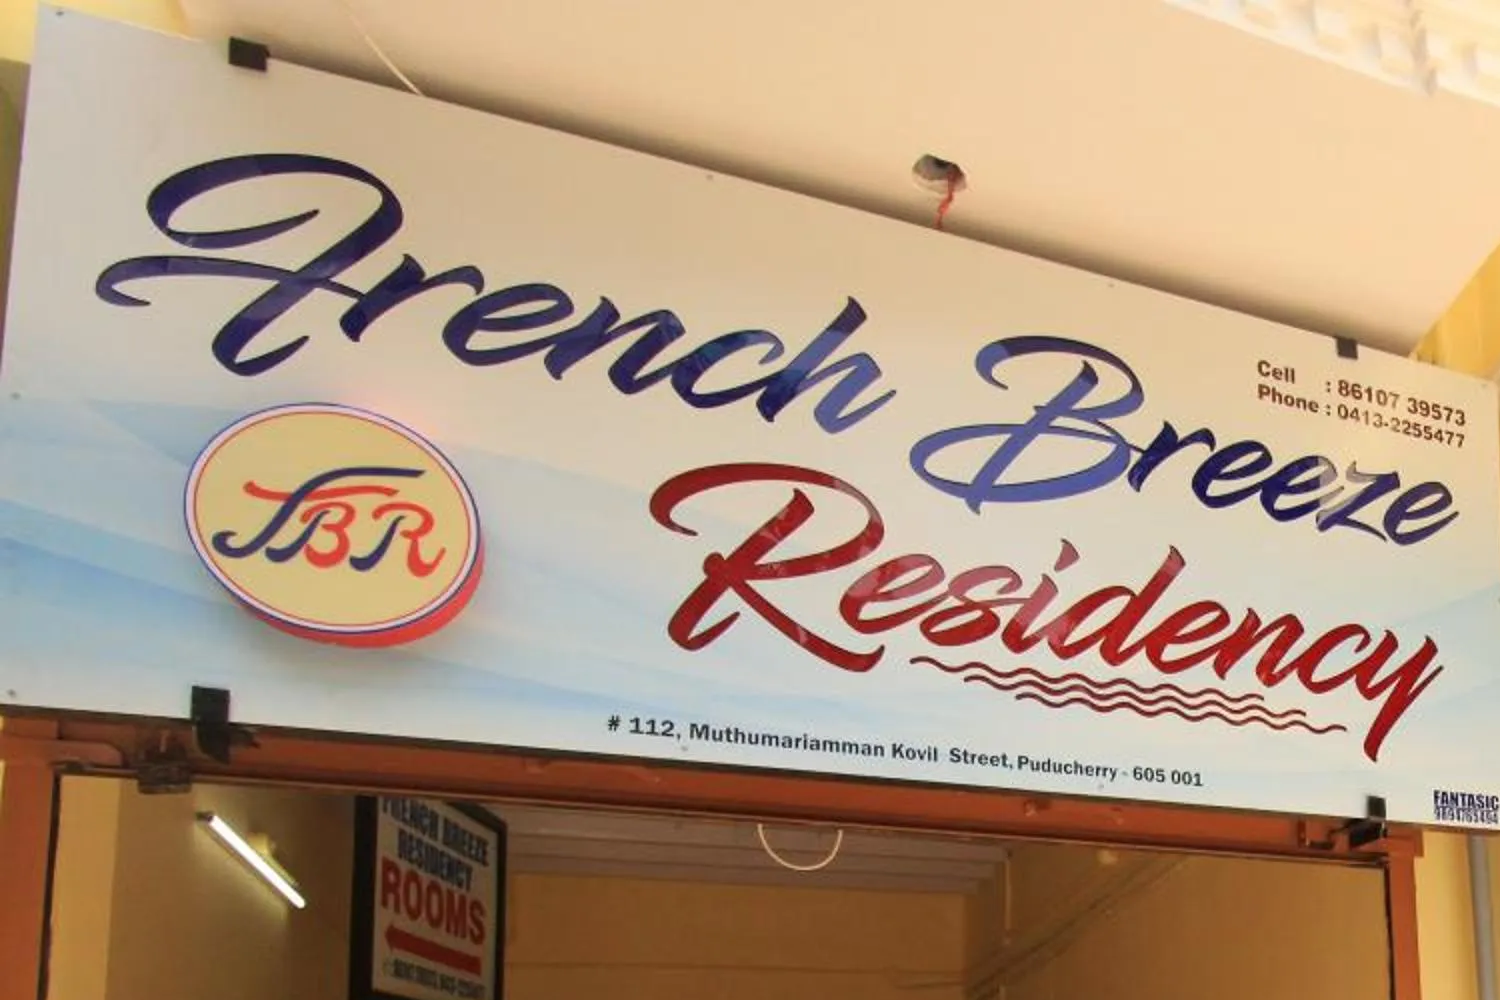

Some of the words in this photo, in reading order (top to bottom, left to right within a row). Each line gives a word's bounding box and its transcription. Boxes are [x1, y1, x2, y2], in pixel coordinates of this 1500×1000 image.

[95, 153, 896, 436] French
[909, 335, 1460, 545] Breeze
[1257, 360, 1295, 384] Cell
[1338, 379, 1400, 408] 86107
[1407, 397, 1466, 426] 39573
[1257, 383, 1319, 413] Phone
[1337, 403, 1466, 448] 0413-2255477
[650, 462, 1445, 762] Residency
[629, 716, 681, 741] 112,
[689, 722, 886, 758] Muthumariamman
[891, 743, 938, 762] Kovil
[949, 747, 1014, 770] Street,
[1017, 755, 1118, 782] Puducherry
[1132, 766, 1166, 783] 605
[1171, 770, 1204, 787] 001
[1433, 790, 1499, 811] FANTASIC
[381, 855, 486, 945] ROOMS
